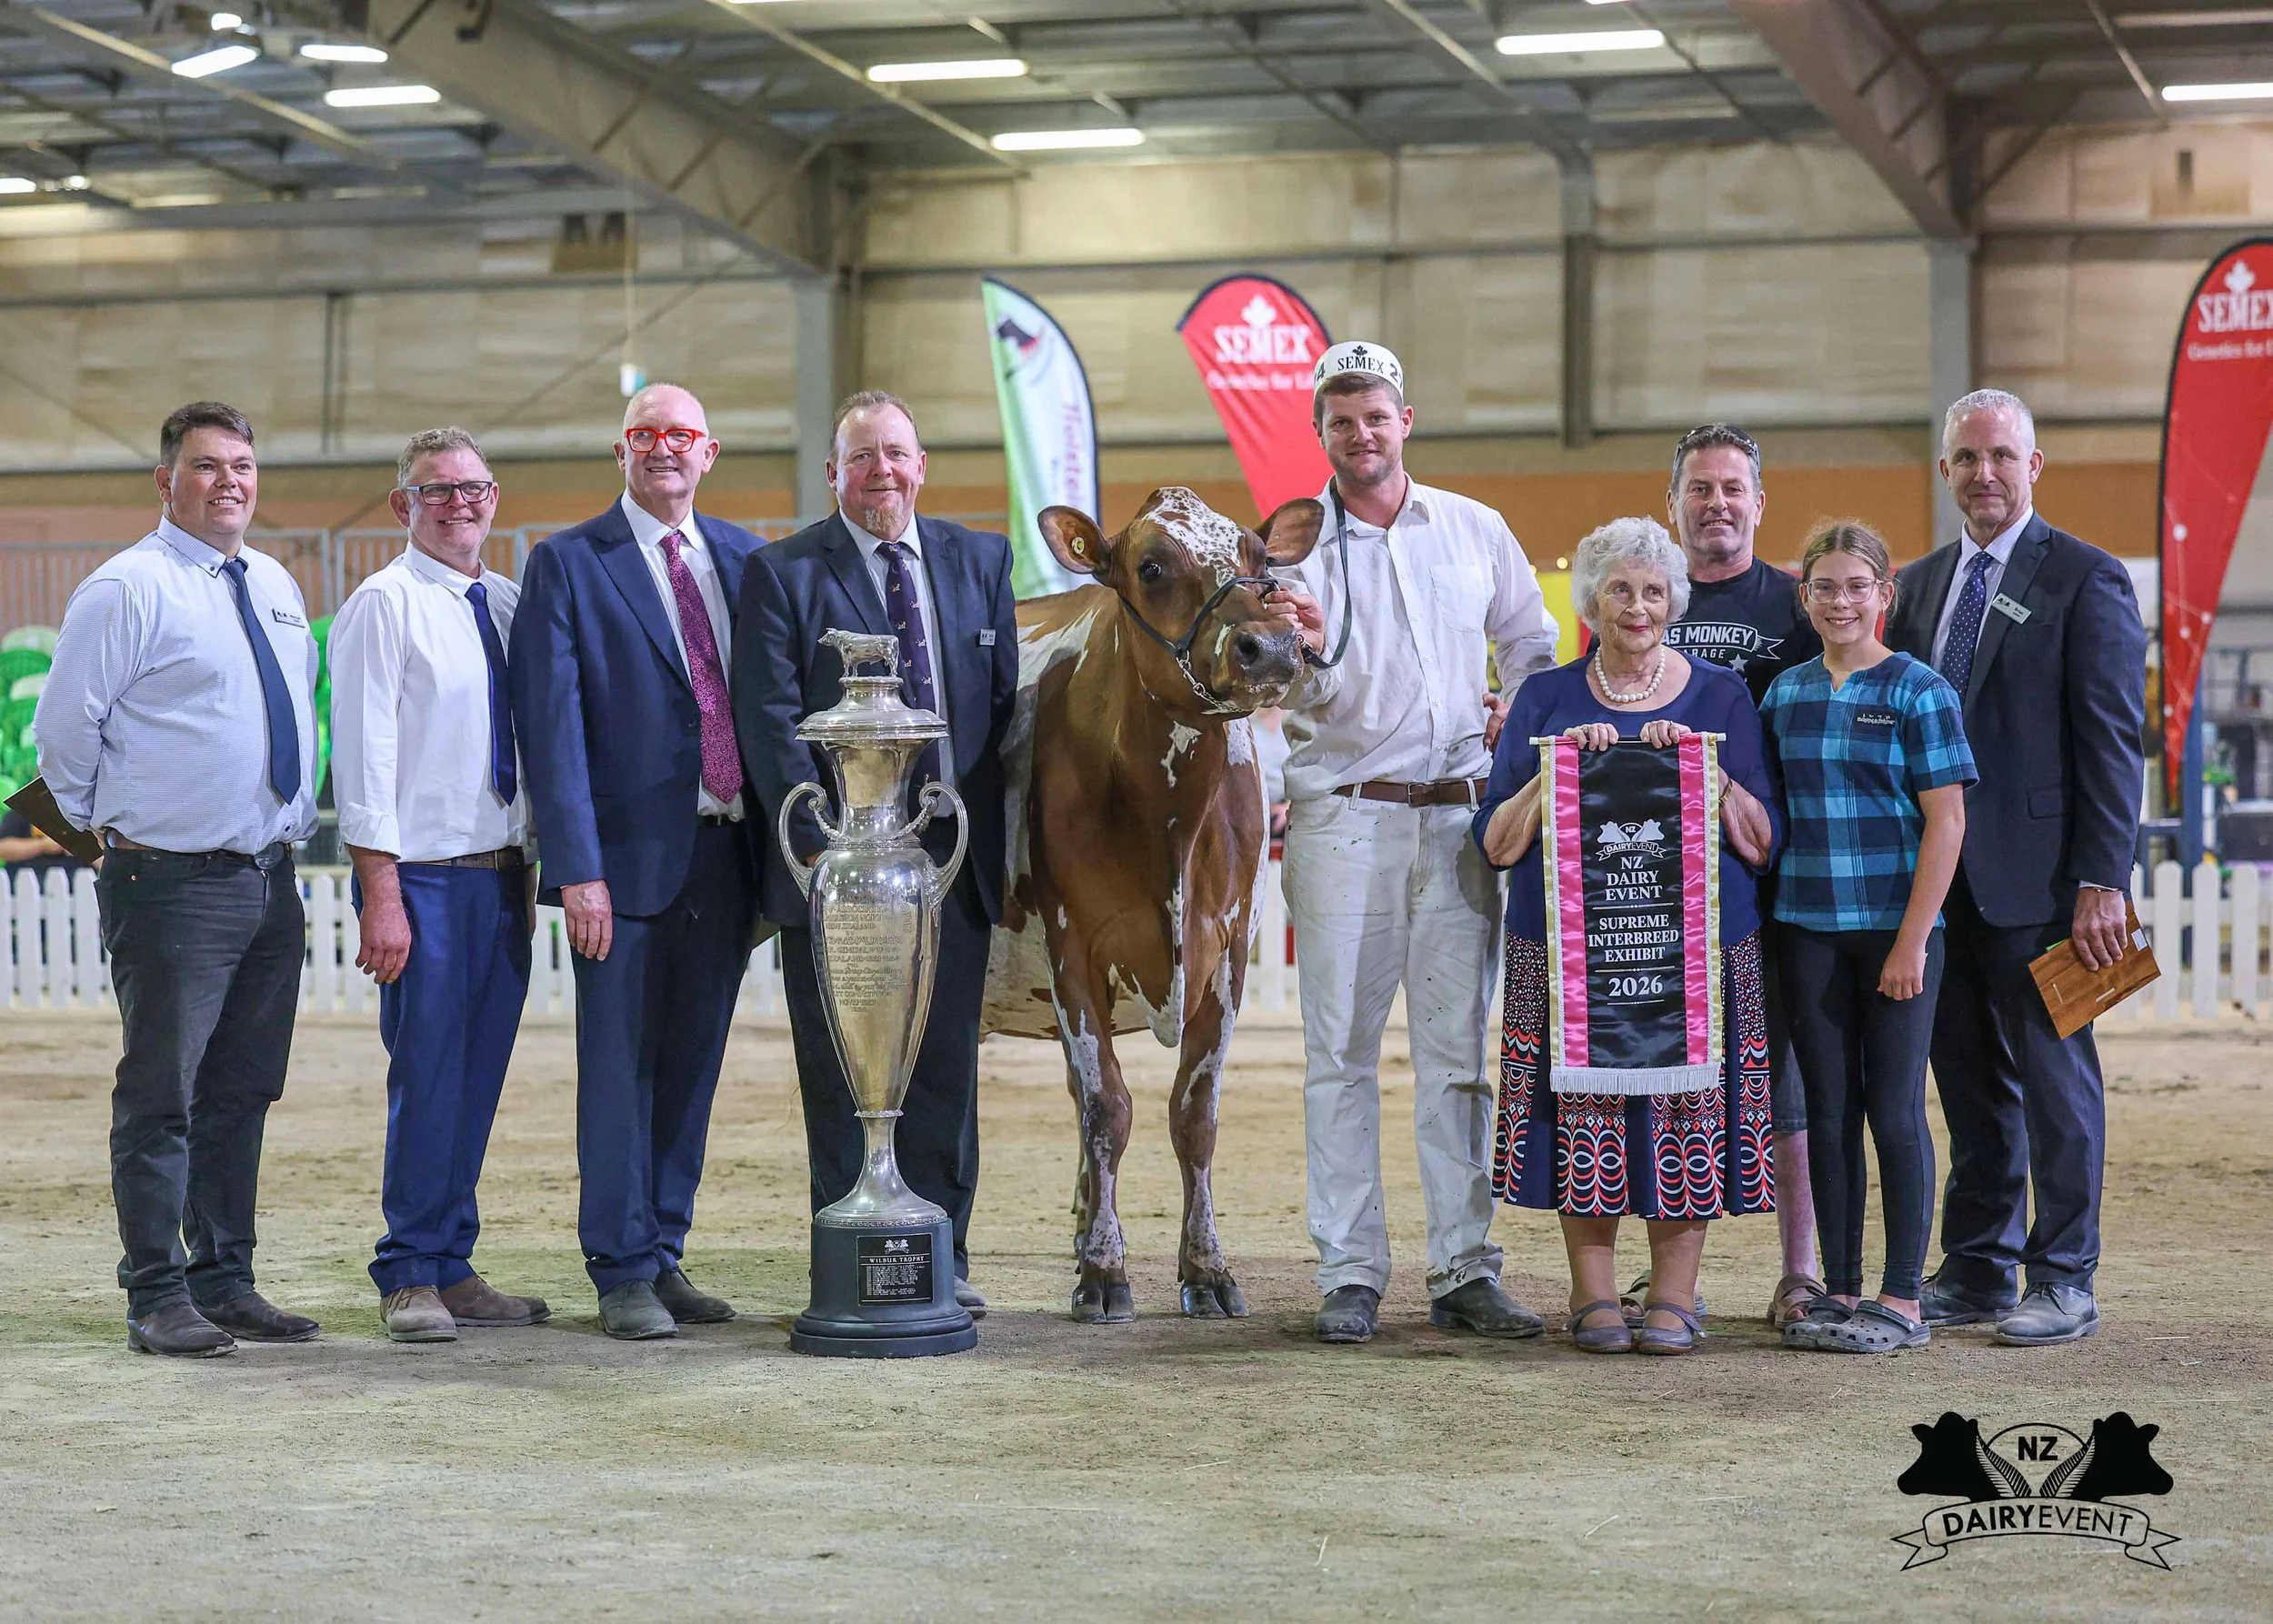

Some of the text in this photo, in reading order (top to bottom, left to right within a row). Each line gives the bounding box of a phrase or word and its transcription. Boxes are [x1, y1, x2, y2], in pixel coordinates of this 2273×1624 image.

[1214, 324, 1312, 364] SEMEX
[1337, 356, 1384, 374] SEMEX
[1685, 626, 1754, 648] MONKEY
[1625, 826, 1637, 834] NZ
[1620, 856, 1644, 870] NZ
[1606, 870, 1659, 887] DAIRY
[1605, 885, 1663, 901] EVENT
[1599, 914, 1669, 930] SUPREME
[1587, 929, 1679, 947] INTERBREED
[1604, 947, 1666, 963] EXHIBIT
[1608, 974, 1663, 997] 2026
